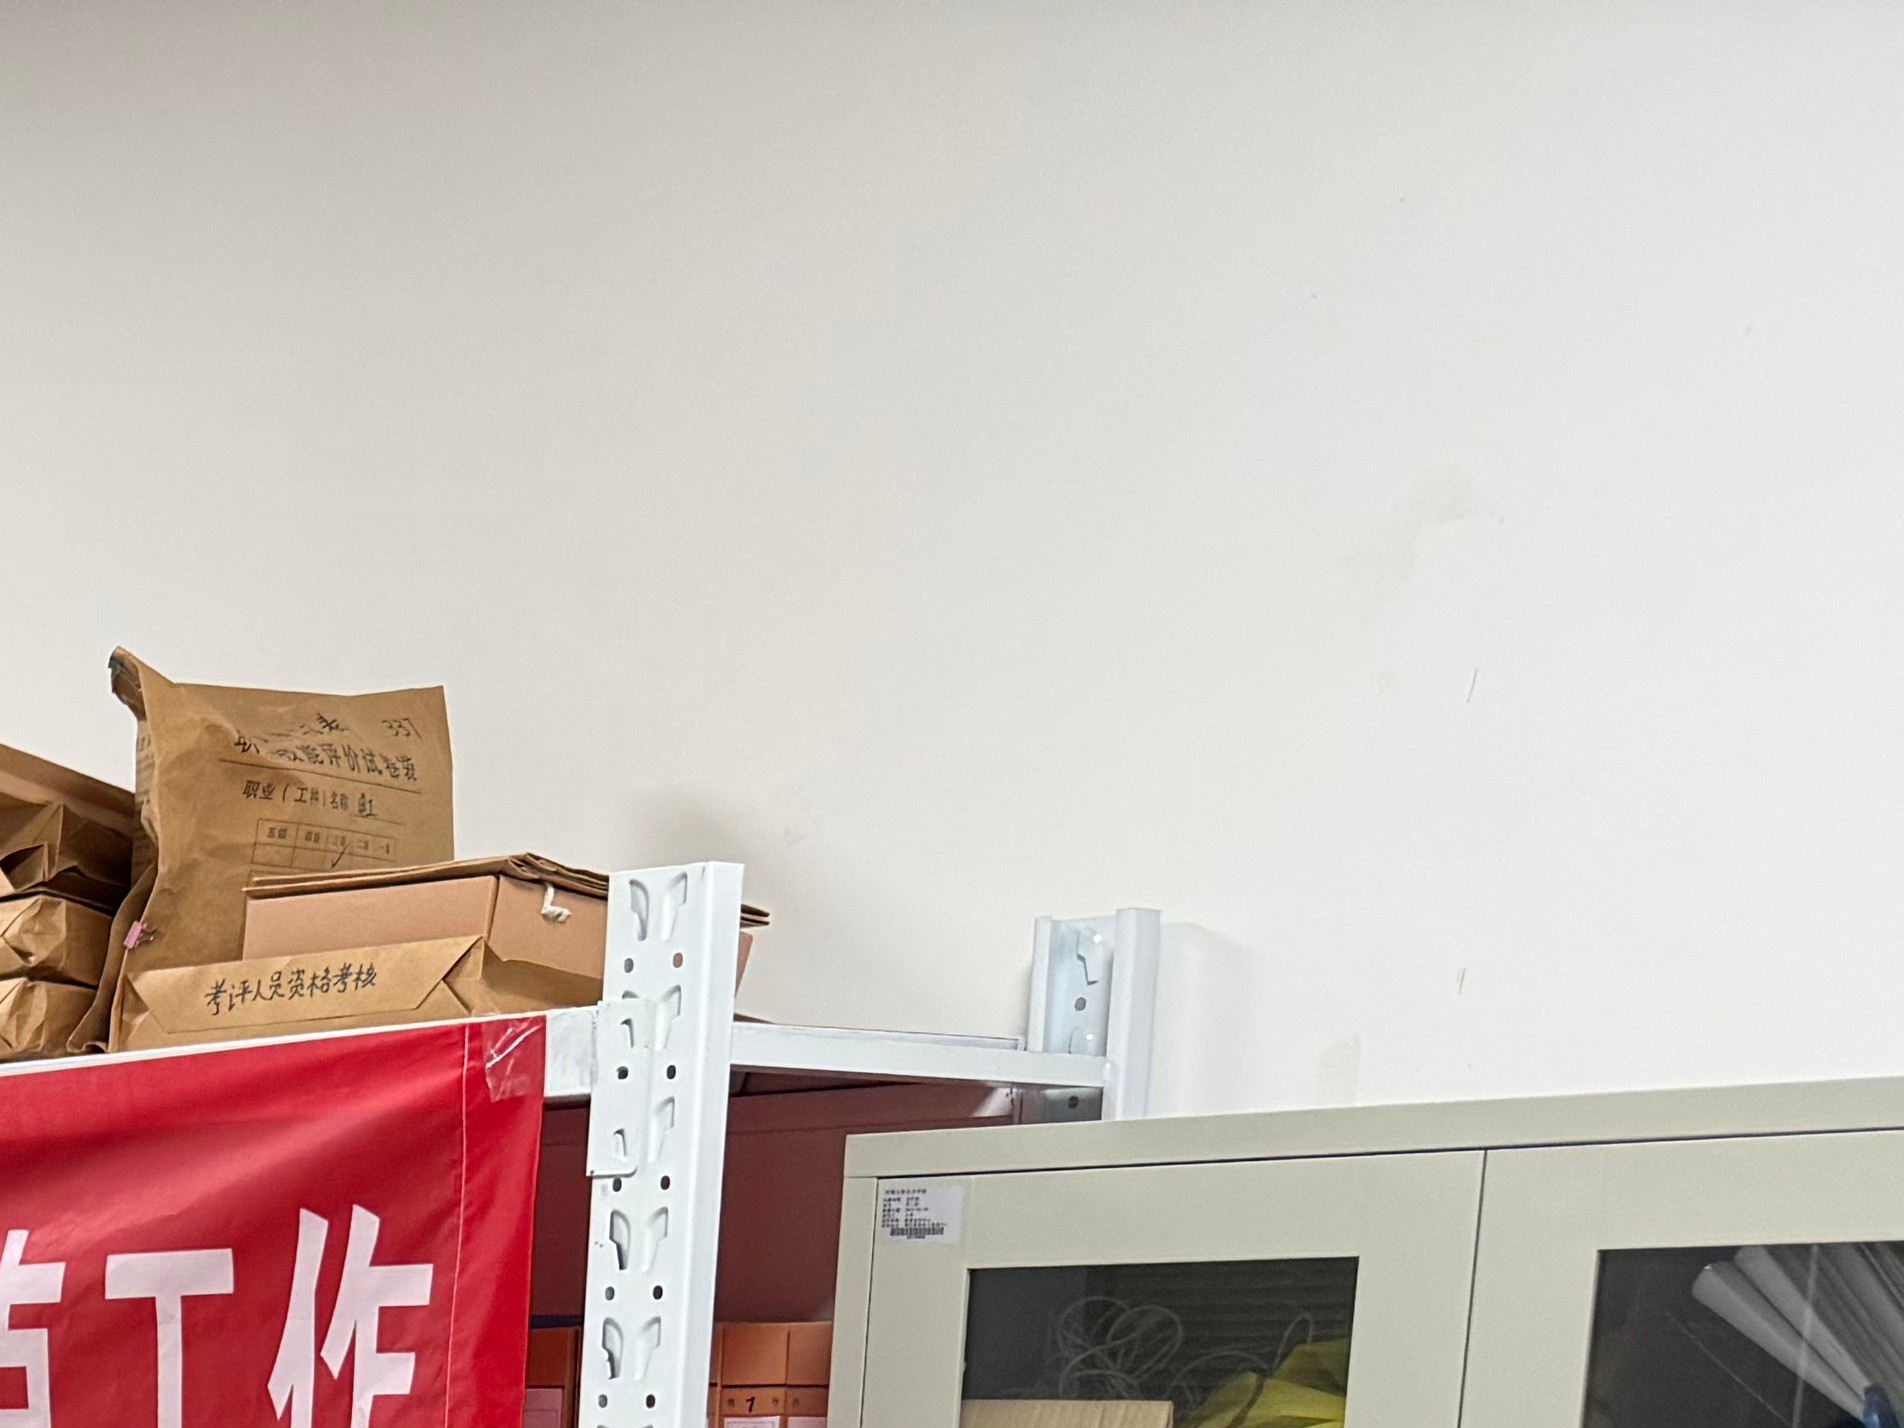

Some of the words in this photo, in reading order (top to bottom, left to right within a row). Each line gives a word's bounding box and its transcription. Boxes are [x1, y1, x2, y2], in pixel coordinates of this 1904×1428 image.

[204, 963, 378, 1016] 考评人员资格考核
